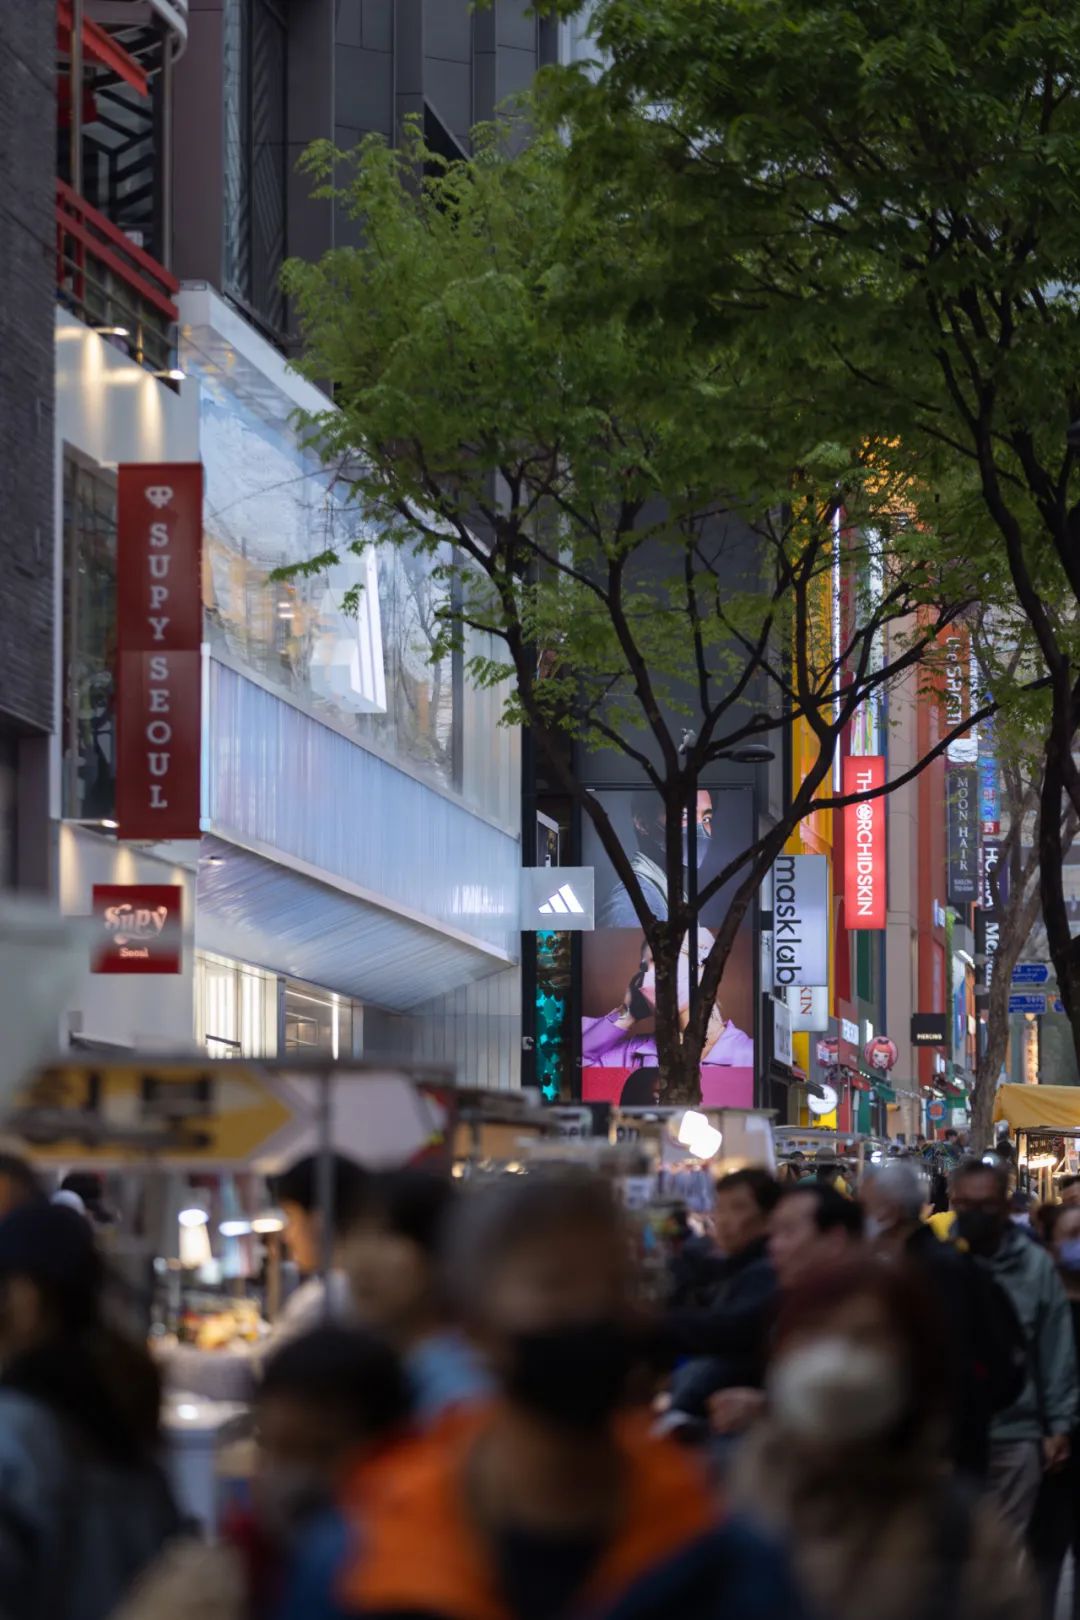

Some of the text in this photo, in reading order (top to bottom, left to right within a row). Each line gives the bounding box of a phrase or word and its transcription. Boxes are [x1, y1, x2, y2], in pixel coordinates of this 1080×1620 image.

[147, 523, 171, 808] SUPY SEOUL
[957, 777, 969, 821] MOON
[958, 827, 969, 871] HAIR
[776, 856, 803, 985] masklab
